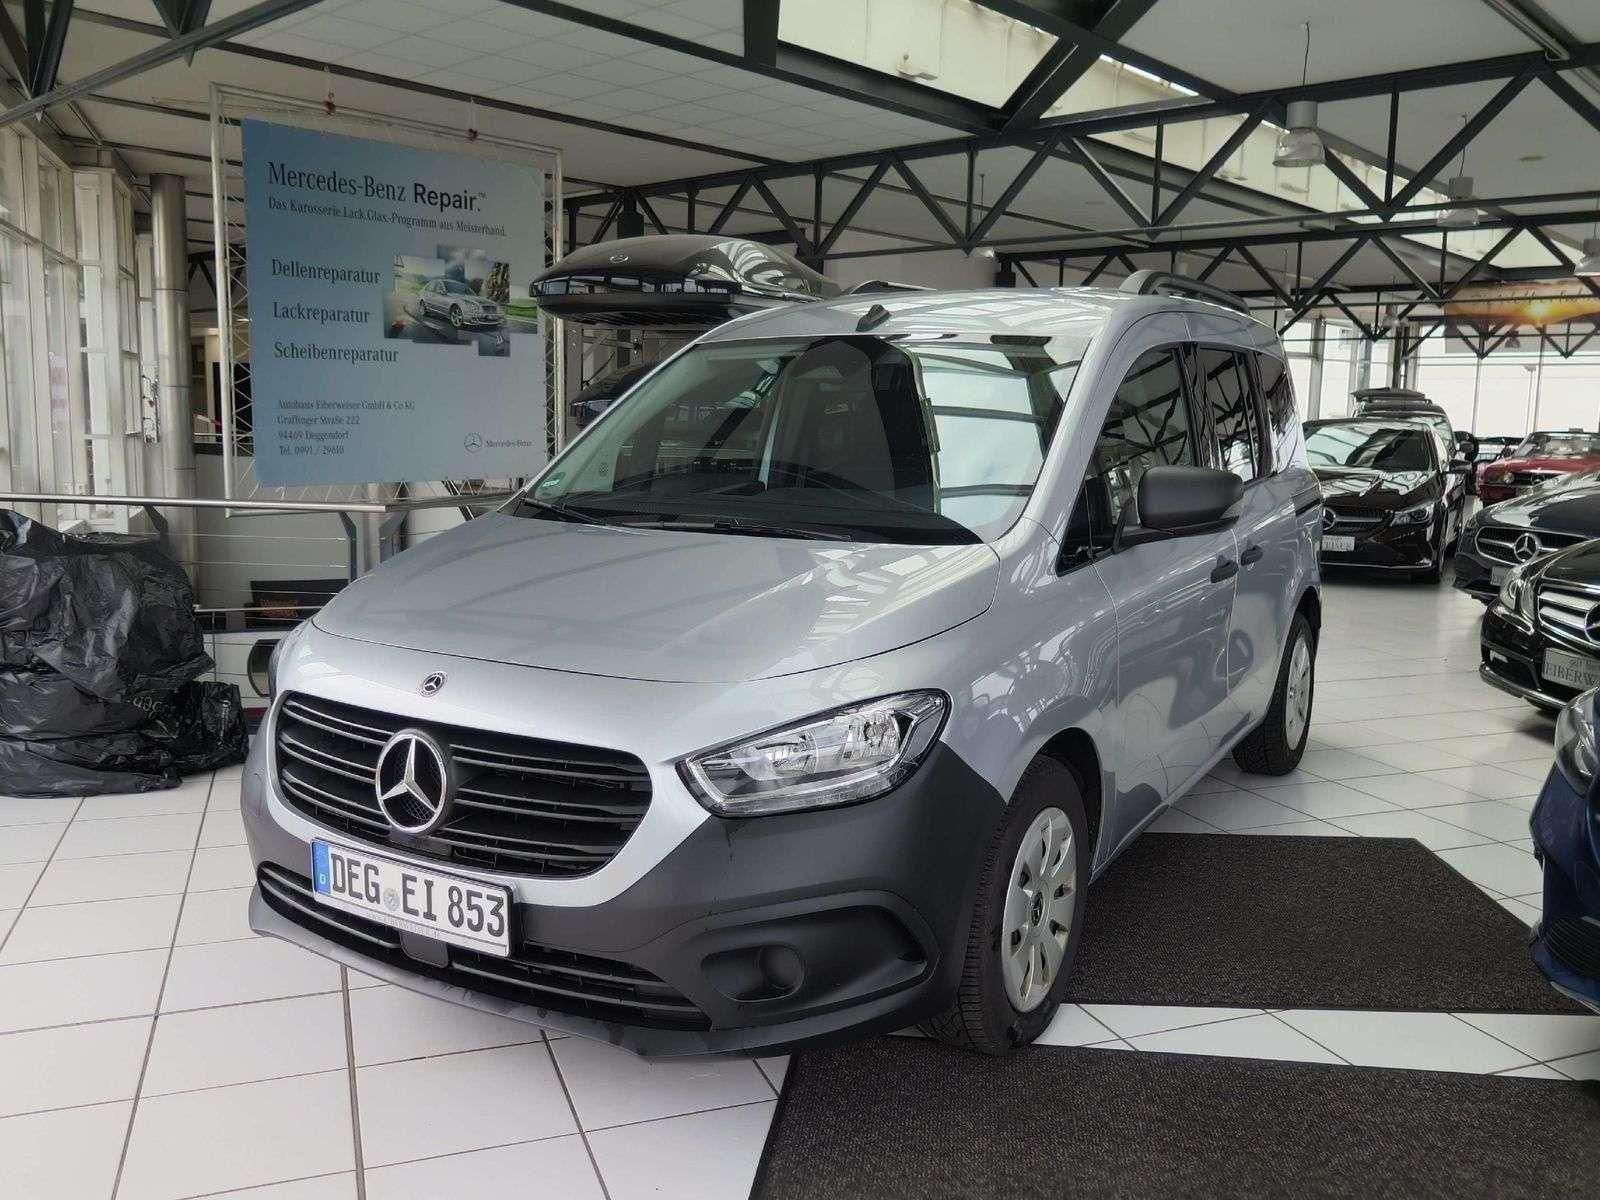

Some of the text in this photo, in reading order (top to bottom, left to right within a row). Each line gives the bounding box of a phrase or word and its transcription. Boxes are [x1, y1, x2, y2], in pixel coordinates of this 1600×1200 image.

[267, 160, 406, 203] Mercedes-Benz
[268, 196, 288, 211] Das
[271, 258, 381, 284] Dellenreparatur
[272, 301, 370, 325] Lackreparatur
[273, 341, 400, 365] Scheibenreparatur
[361, 401, 384, 410] GmbH
[346, 415, 360, 425] 222
[278, 430, 349, 441] 94469 Deggendorf
[331, 853, 381, 905] DEG
[402, 873, 437, 922] EI
[447, 885, 505, 937] 853
